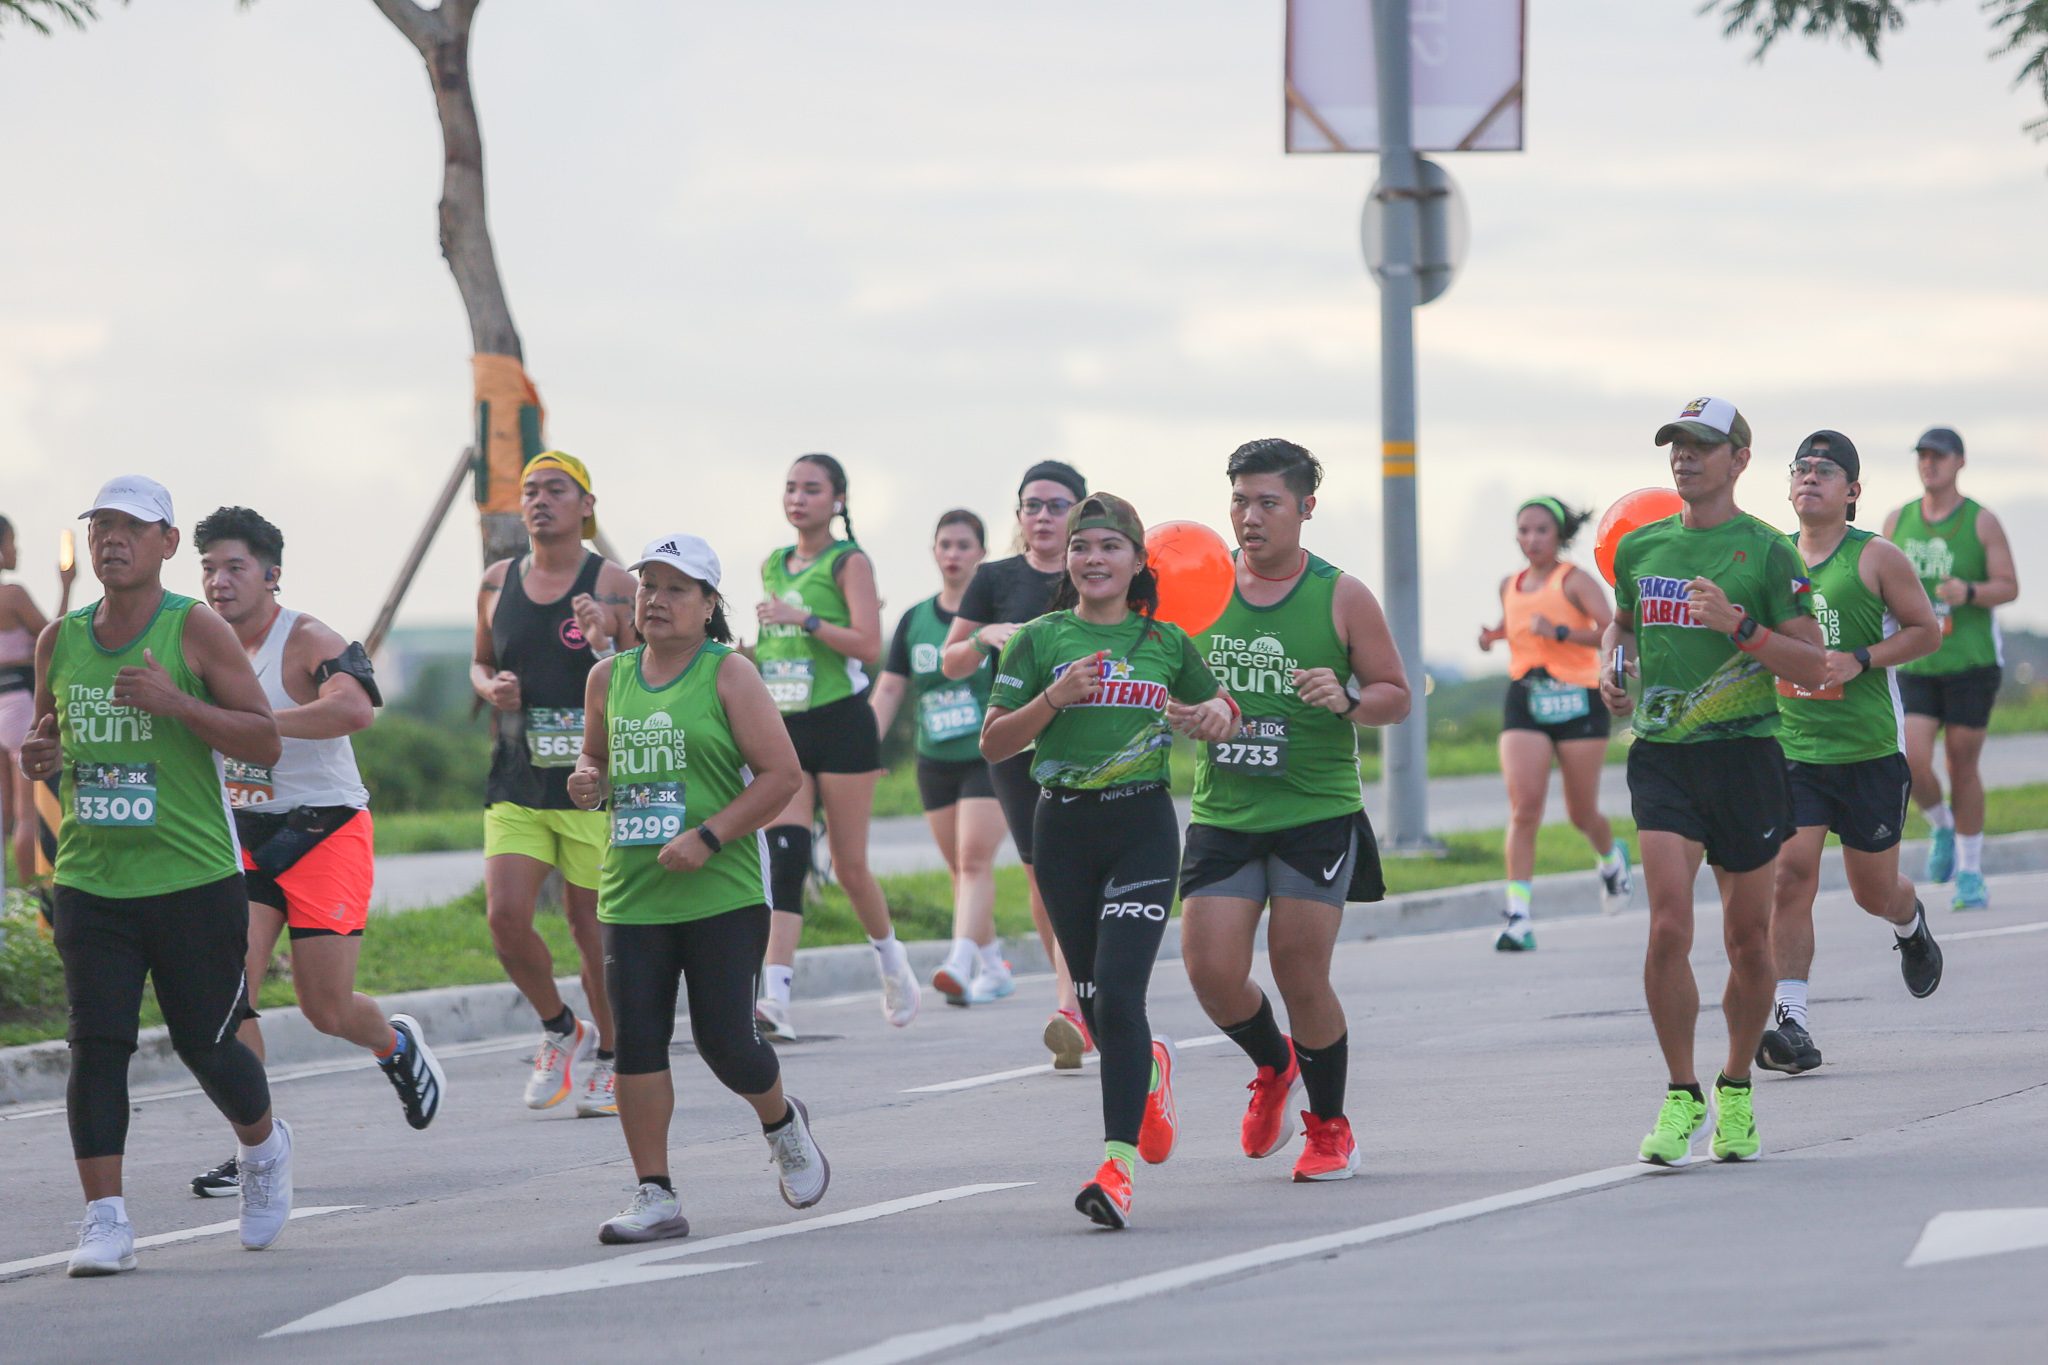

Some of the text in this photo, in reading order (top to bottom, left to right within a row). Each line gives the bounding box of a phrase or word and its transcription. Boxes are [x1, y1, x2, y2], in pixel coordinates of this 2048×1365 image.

[655, 548, 681, 557] adidas
[1639, 578, 1690, 600] TAKBO
[1642, 600, 1744, 627] KABIT
[1828, 609, 1841, 646] 2024
[1210, 634, 1247, 651] The
[1208, 650, 1284, 671] Green
[1209, 666, 1282, 694] Run
[1282, 657, 1298, 695] 2024
[68, 683, 105, 701] The
[1063, 680, 1167, 710] ITENYO
[68, 716, 139, 744] Run
[139, 710, 153, 741] 024
[611, 716, 642, 733] The
[1261, 723, 1285, 736] 10K
[536, 735, 585, 757] 563
[610, 729, 673, 750] Green
[673, 728, 687, 771] 2024
[612, 745, 674, 777] Run
[1216, 742, 1278, 767] 2733
[128, 772, 148, 784] 3K
[658, 790, 677, 802] 3K
[1041, 785, 1053, 799] RO
[1100, 786, 1135, 802] NIKE
[80, 796, 154, 821] 3300
[616, 815, 681, 841] 3299
[1101, 902, 1166, 921] PRO
